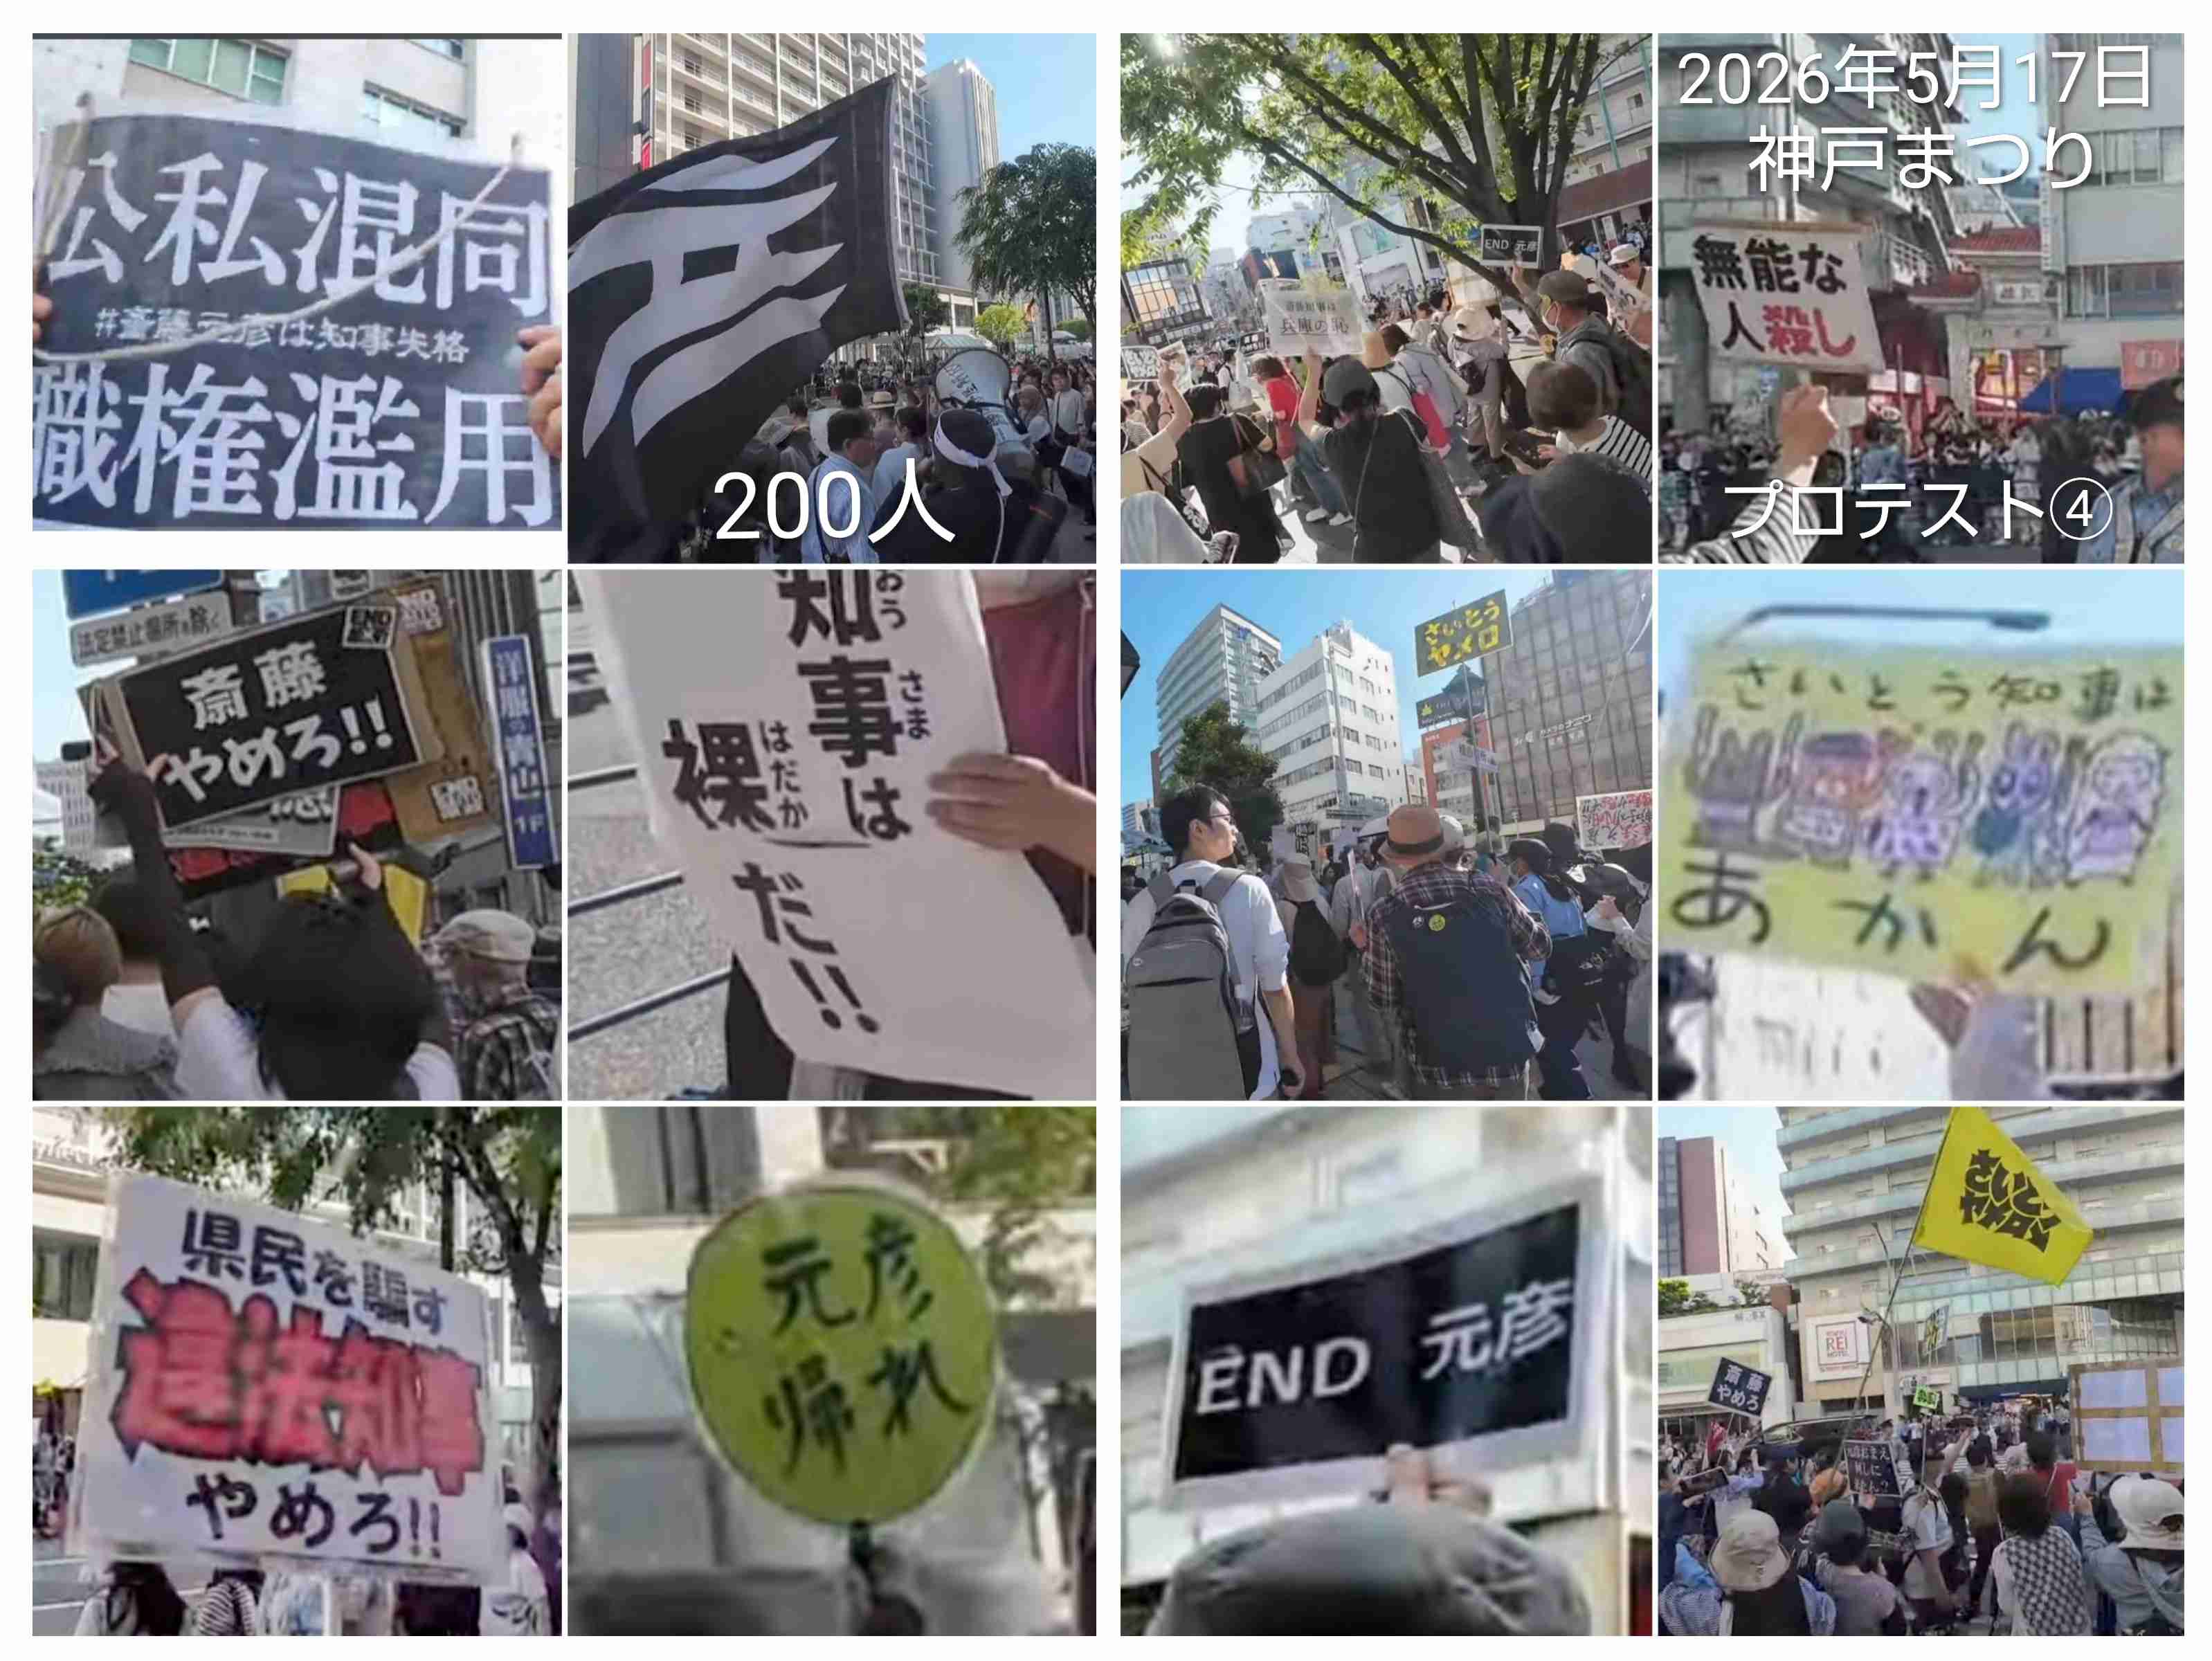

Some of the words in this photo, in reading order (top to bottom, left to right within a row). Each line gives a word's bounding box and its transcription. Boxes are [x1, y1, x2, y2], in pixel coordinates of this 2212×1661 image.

[46, 150, 549, 316] 公私混同
[1485, 238, 1510, 250] END
[1693, 233, 1848, 294] 無能な
[1723, 302, 1858, 357] 人殺し
[33, 361, 552, 526] 職権濫用
[1424, 598, 1501, 646] さいとう
[1429, 624, 1499, 666] ヤメロ
[181, 639, 327, 730] 斎藤
[777, 570, 912, 841] 知事は
[1730, 657, 2172, 723] さいとう知事は
[164, 697, 393, 802] やめろ!!
[760, 721, 808, 829] はだか
[1671, 851, 2111, 973] あかん
[762, 1213, 933, 1336] 元彦
[1196, 1336, 1371, 1415] END
[1421, 1280, 1573, 1380] 元彦
[1826, 1336, 1848, 1351] REI
[763, 1341, 970, 1476] 帰れ
[1716, 1383, 1759, 1411] やめろ
[187, 1471, 441, 1559] やめろ!!
